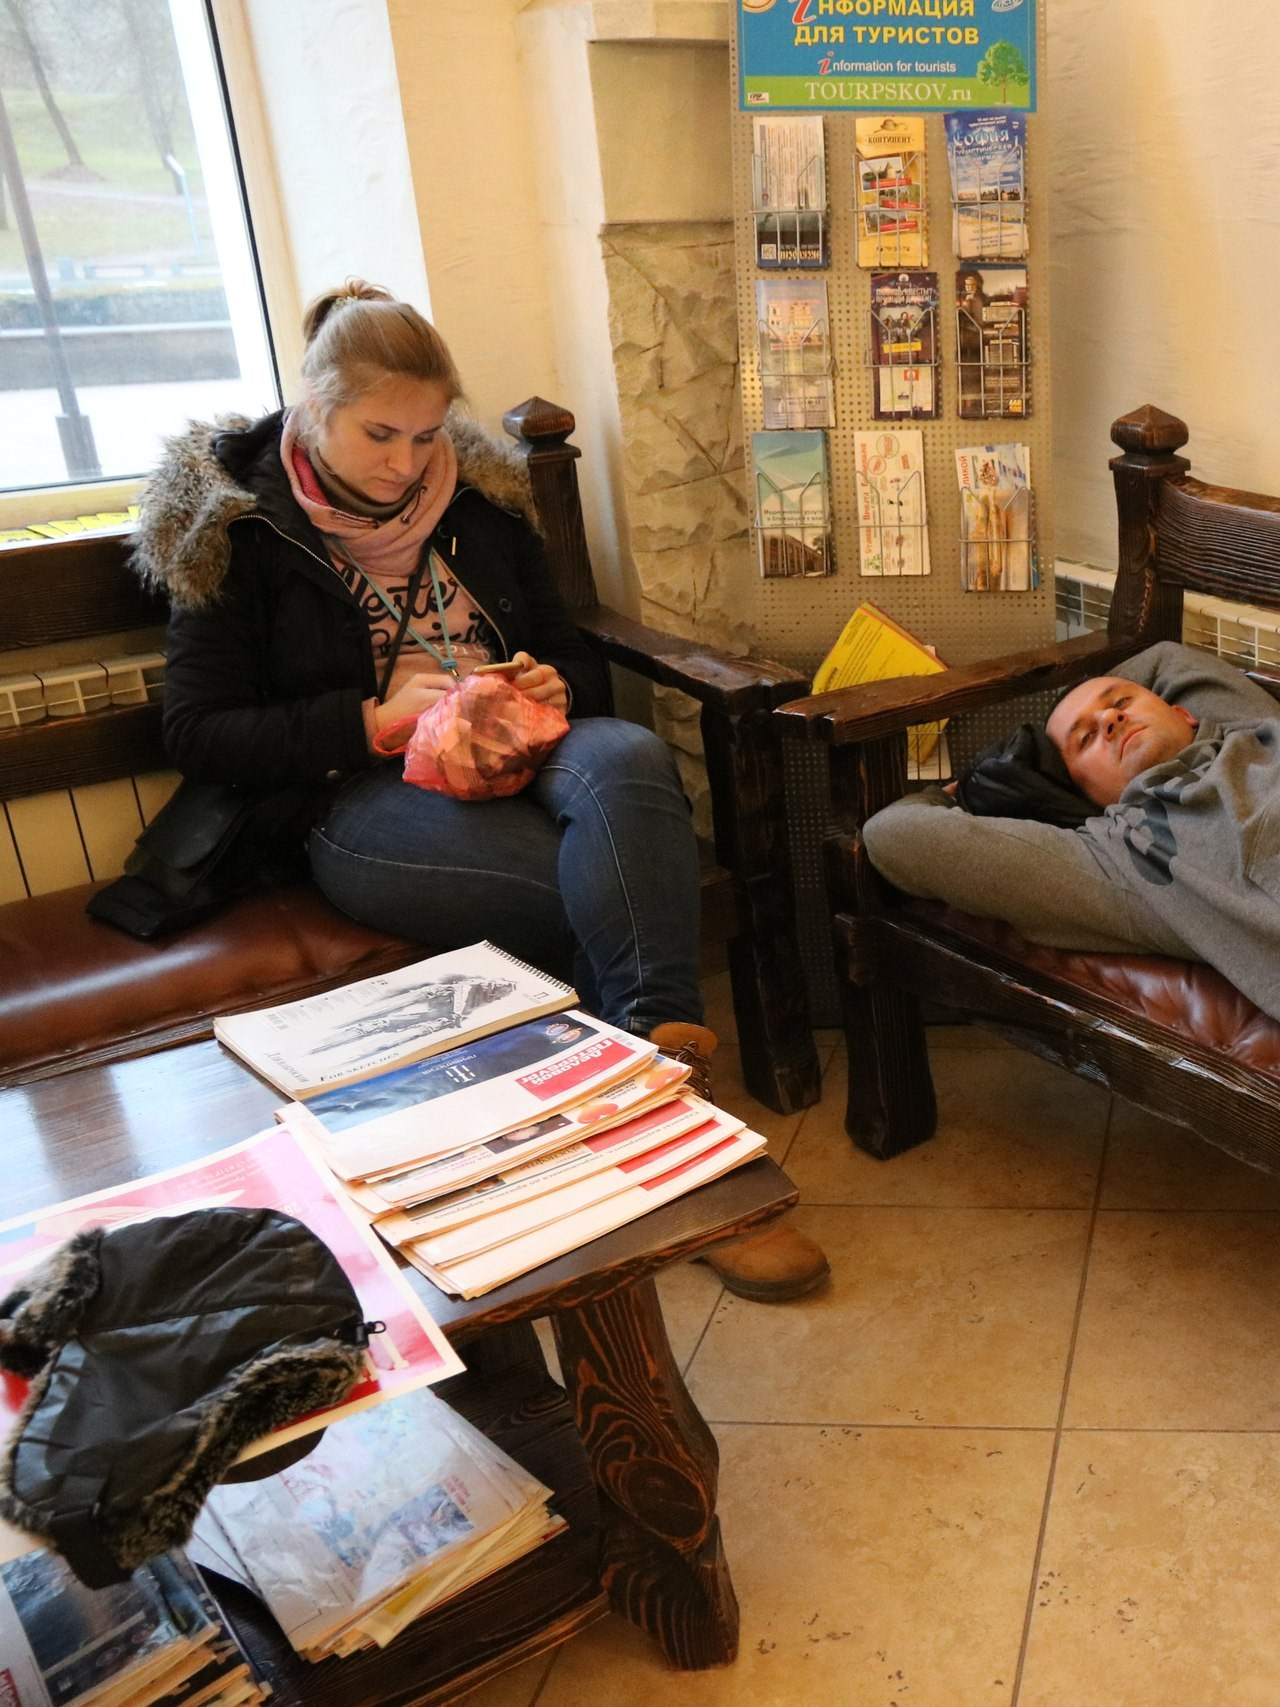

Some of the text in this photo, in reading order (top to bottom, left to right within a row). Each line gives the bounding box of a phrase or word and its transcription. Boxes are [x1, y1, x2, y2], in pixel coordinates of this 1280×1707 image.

[794, 26, 980, 46] ДЛЯ ТУРИСТОВ
[817, 52, 957, 75] information for tourists
[804, 81, 972, 101] TOURPSKOV.ru
[958, 456, 970, 488] ЛИКОЙ
